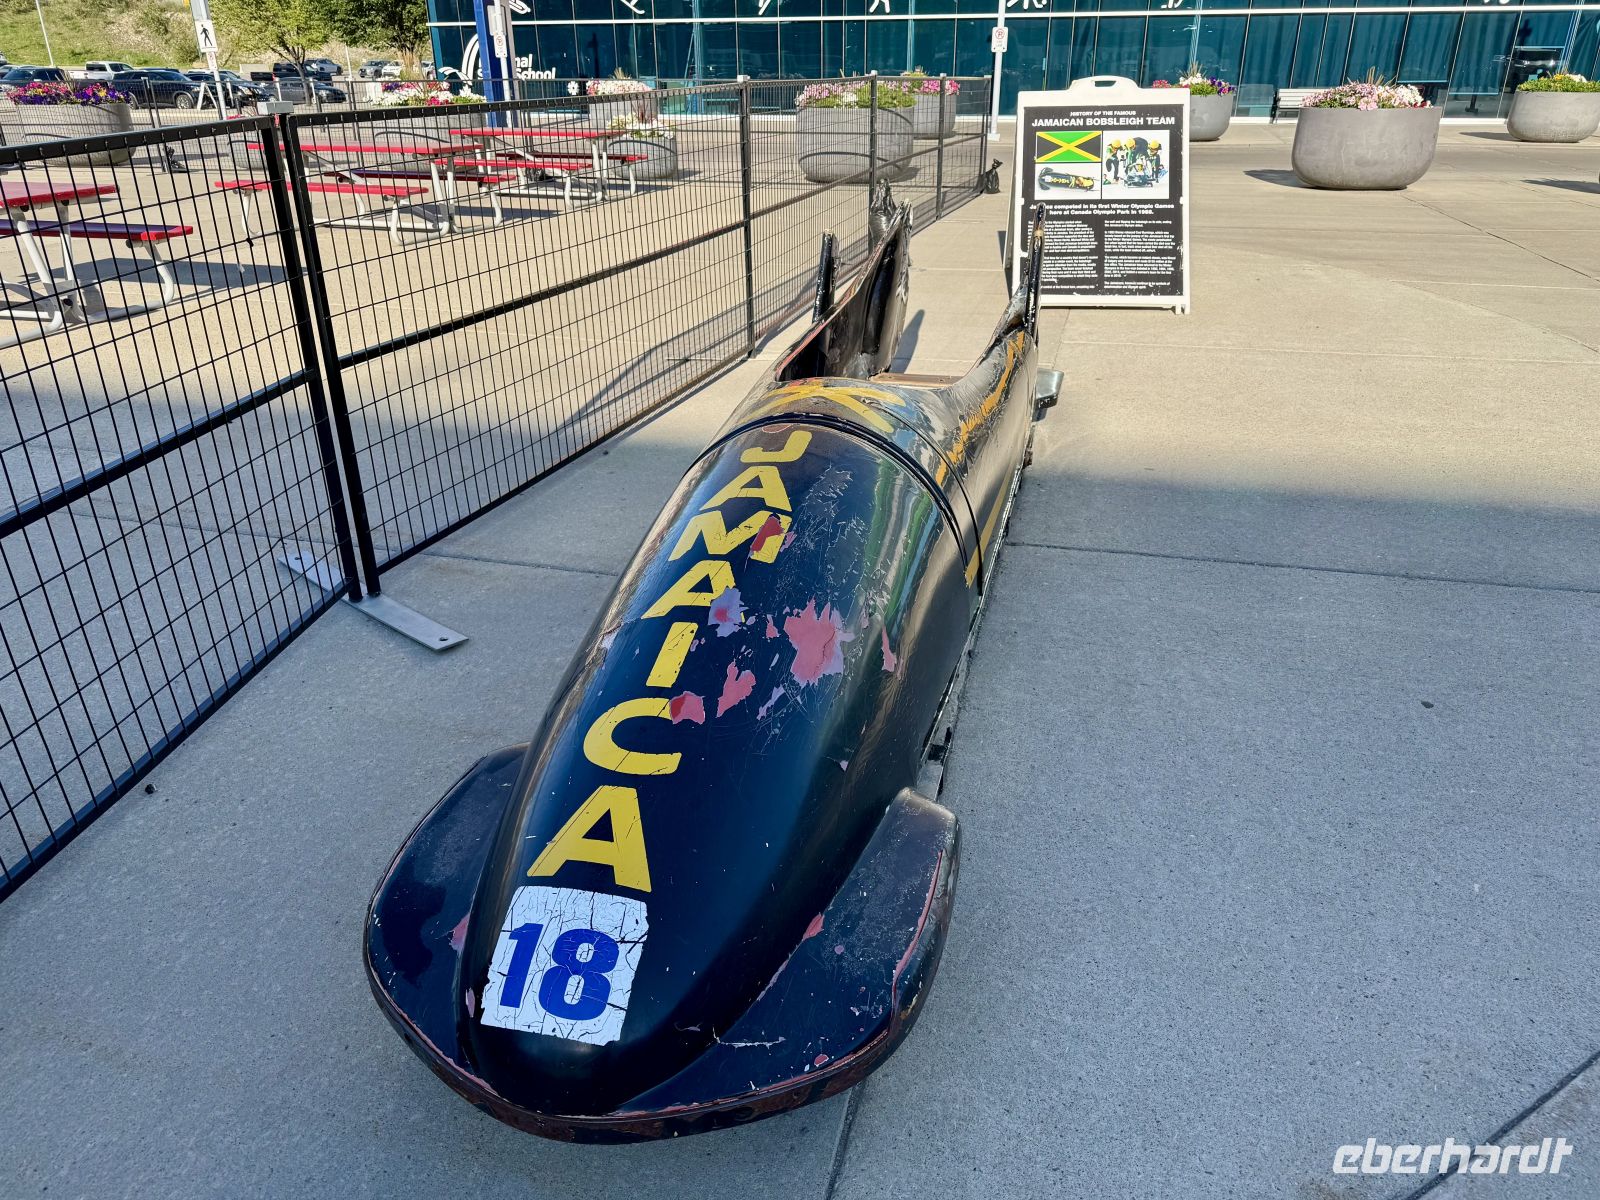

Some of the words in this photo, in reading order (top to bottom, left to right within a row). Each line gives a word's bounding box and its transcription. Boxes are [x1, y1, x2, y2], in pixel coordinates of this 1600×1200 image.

[1031, 118, 1084, 127] JAMAICAN
[1086, 117, 1144, 126] BOBSLEIGH
[1146, 116, 1175, 125] TEAM
[527, 431, 812, 893] JAMAICA
[500, 922, 620, 1021] 18
